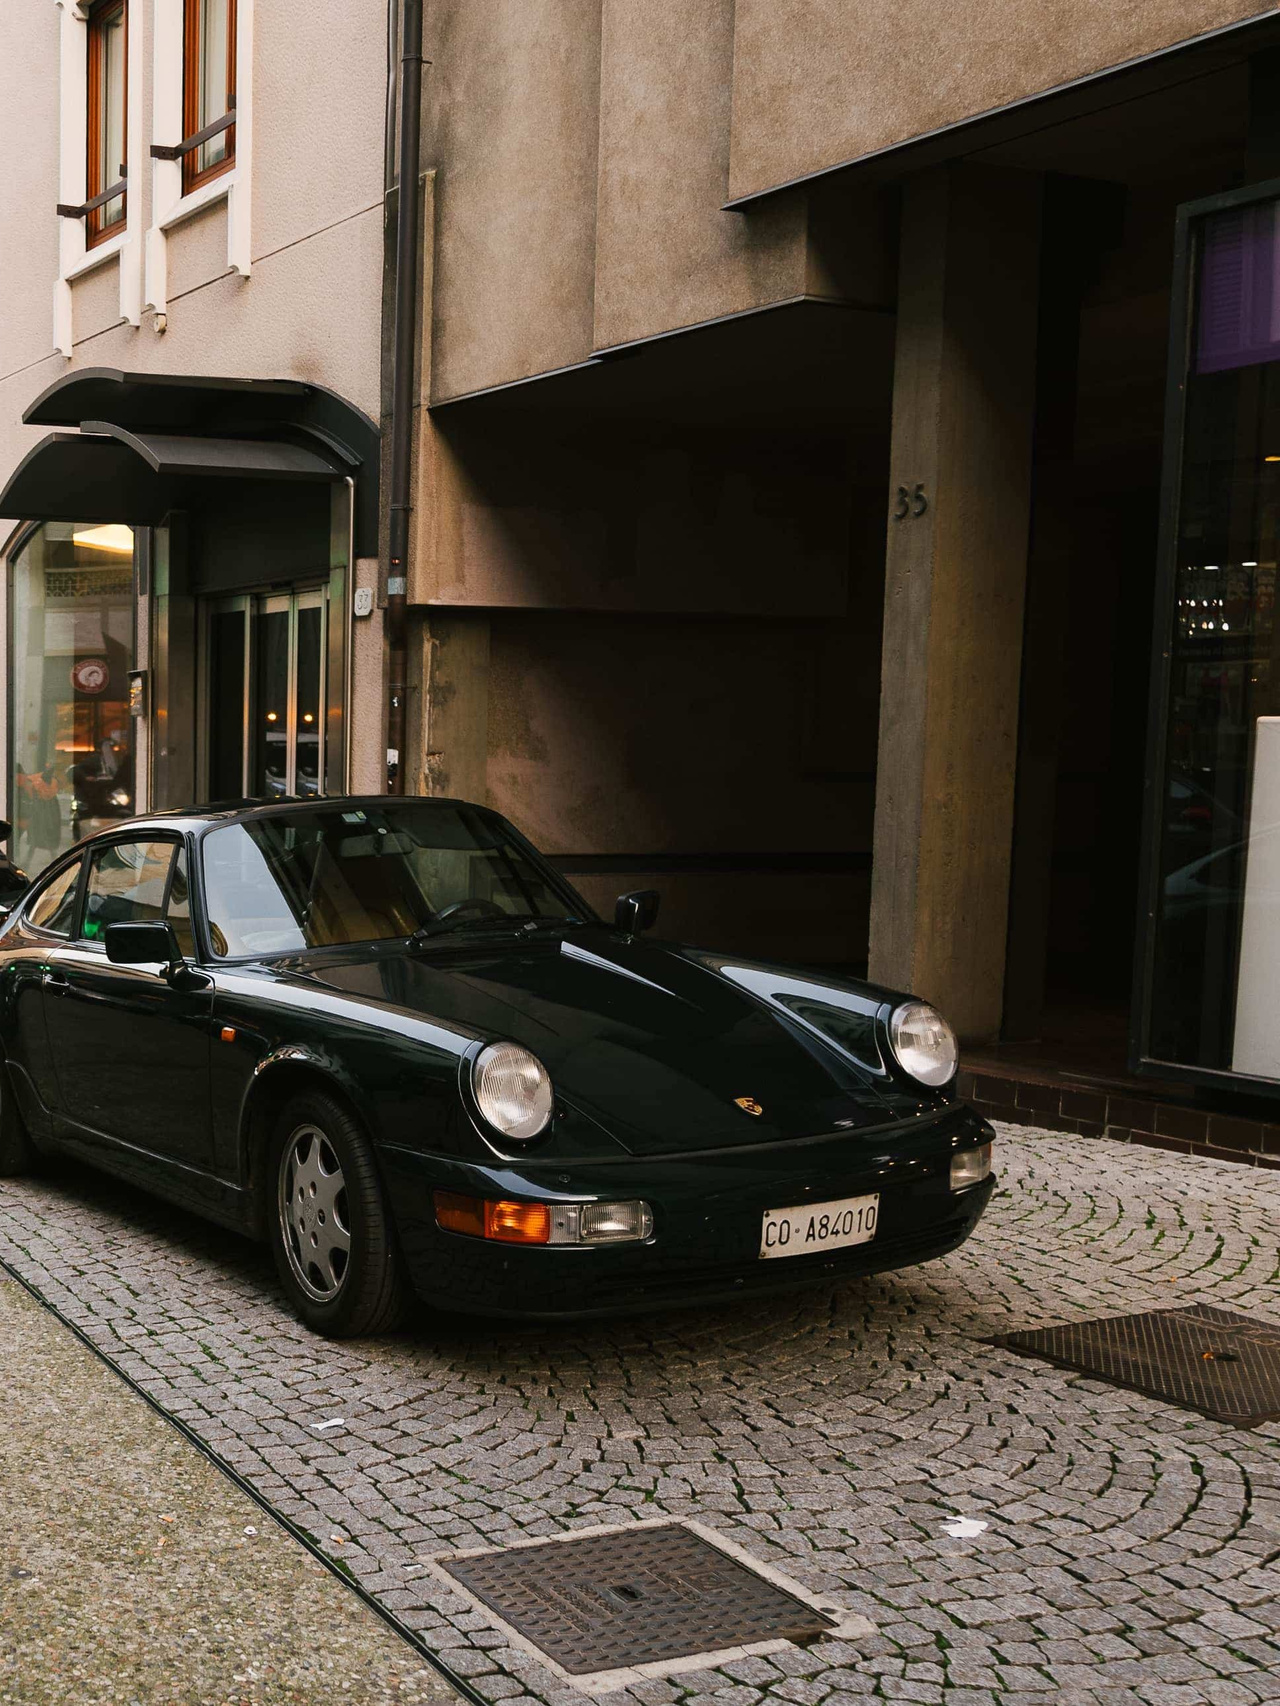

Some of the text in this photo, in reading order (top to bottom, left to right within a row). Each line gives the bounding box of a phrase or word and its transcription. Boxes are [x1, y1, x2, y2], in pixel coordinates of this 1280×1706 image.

[894, 482, 928, 520] 35
[765, 1205, 877, 1248] CO A84010
